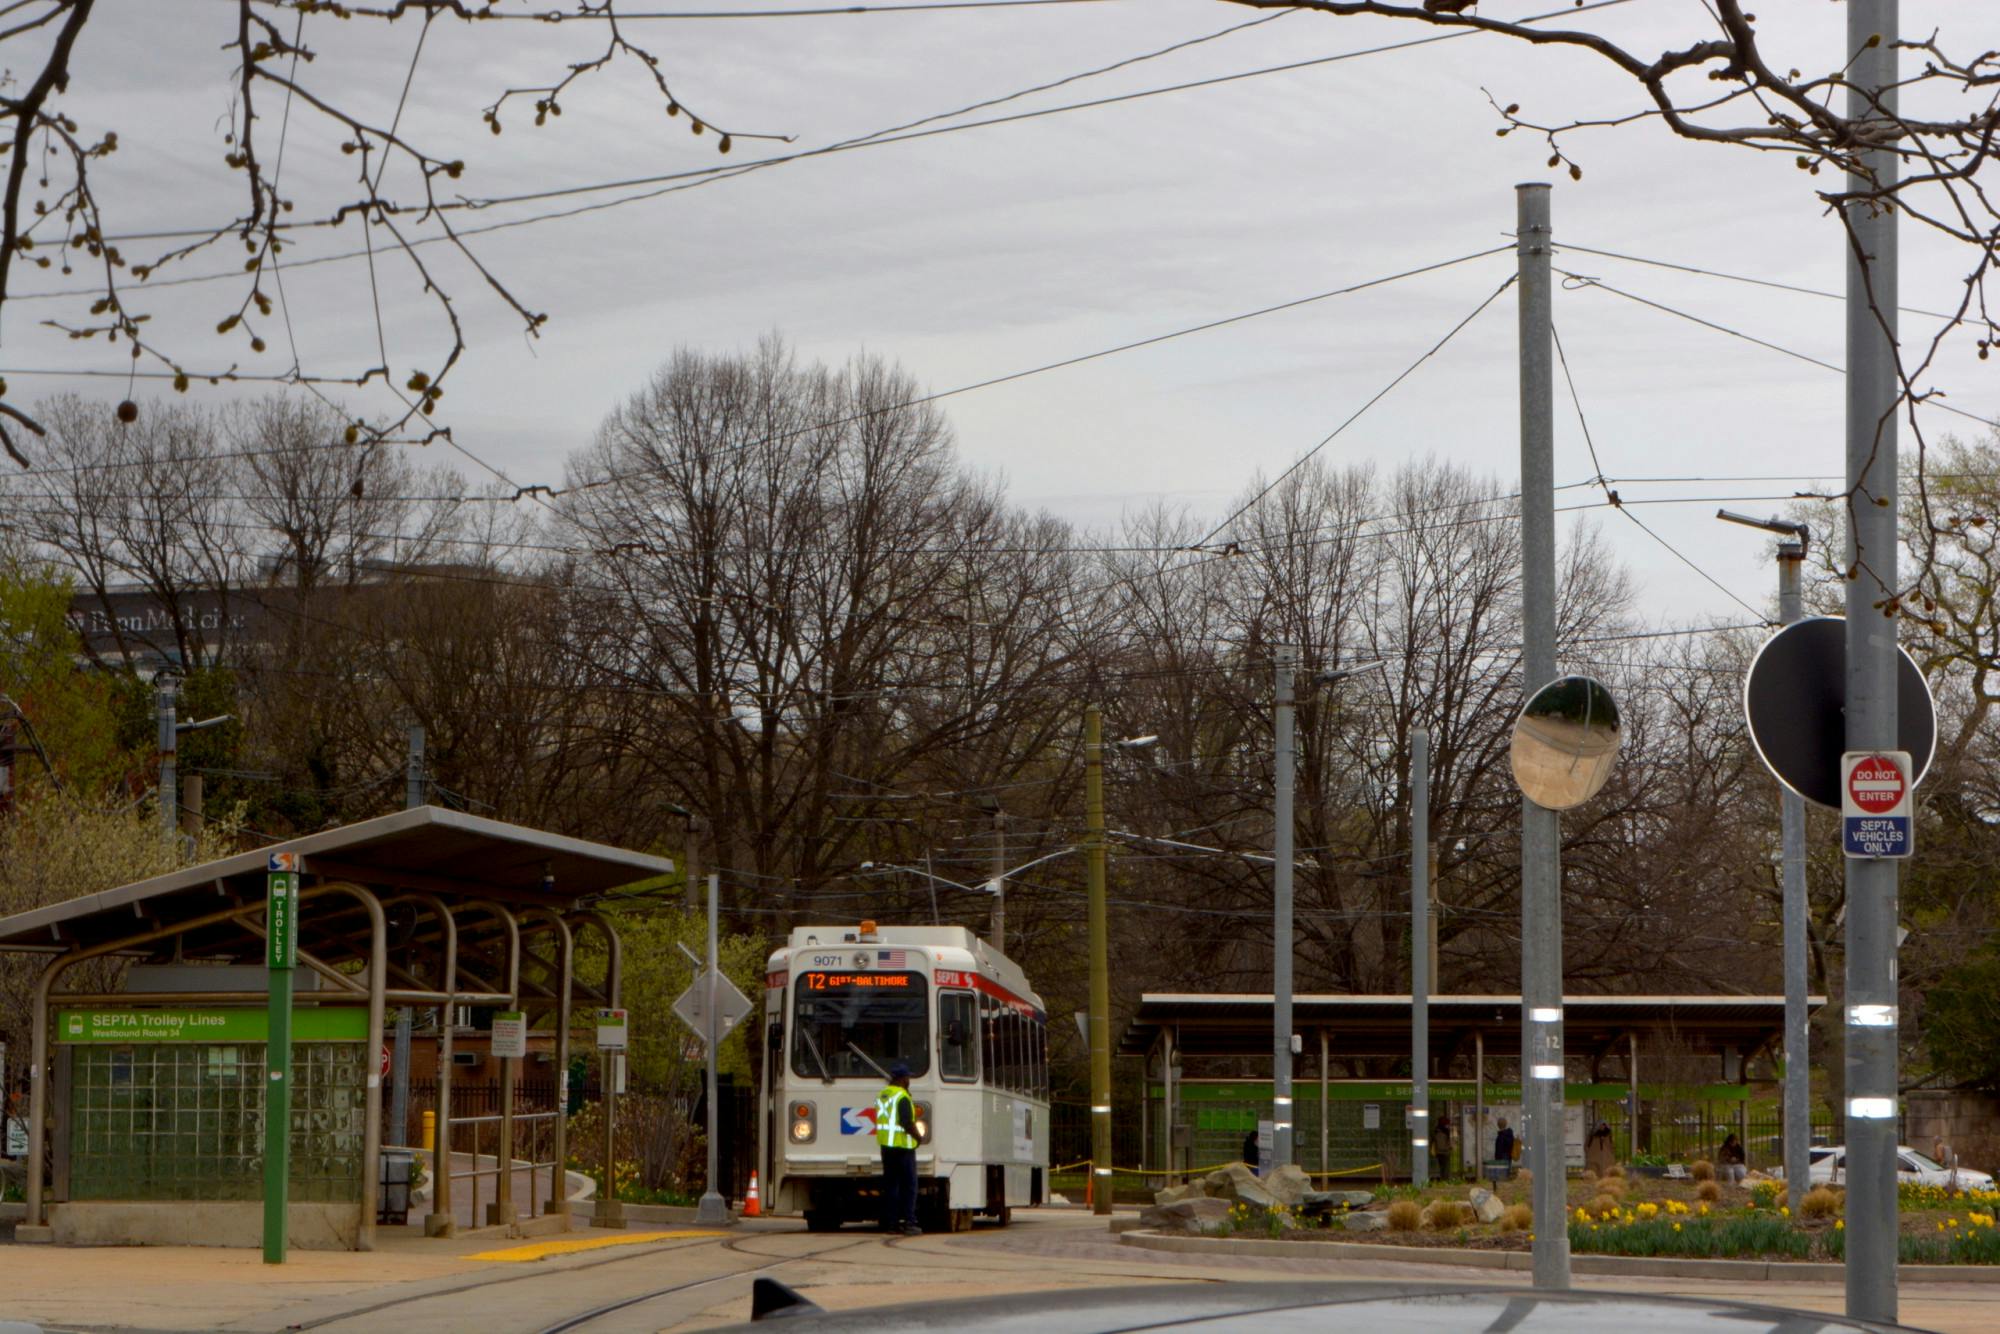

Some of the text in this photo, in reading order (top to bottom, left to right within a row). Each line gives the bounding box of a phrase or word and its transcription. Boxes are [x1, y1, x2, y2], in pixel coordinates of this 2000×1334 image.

[1856, 770, 1897, 780] DO NOT
[1859, 791, 1895, 801] ENTER
[1860, 820, 1895, 831] SEPTA
[1852, 831, 1904, 842] VEHICLES
[1863, 842, 1892, 853] ONLY
[275, 901, 283, 964] TROLLEY
[814, 955, 842, 967] 9071
[807, 973, 826, 990] T2
[936, 970, 960, 985] SEPTA
[92, 1014, 225, 1029] SEPTA Trolley Lines
[92, 1029, 140, 1038] Westbound
[142, 1029, 168, 1038] Route
[1546, 1035, 1560, 1049] 12
